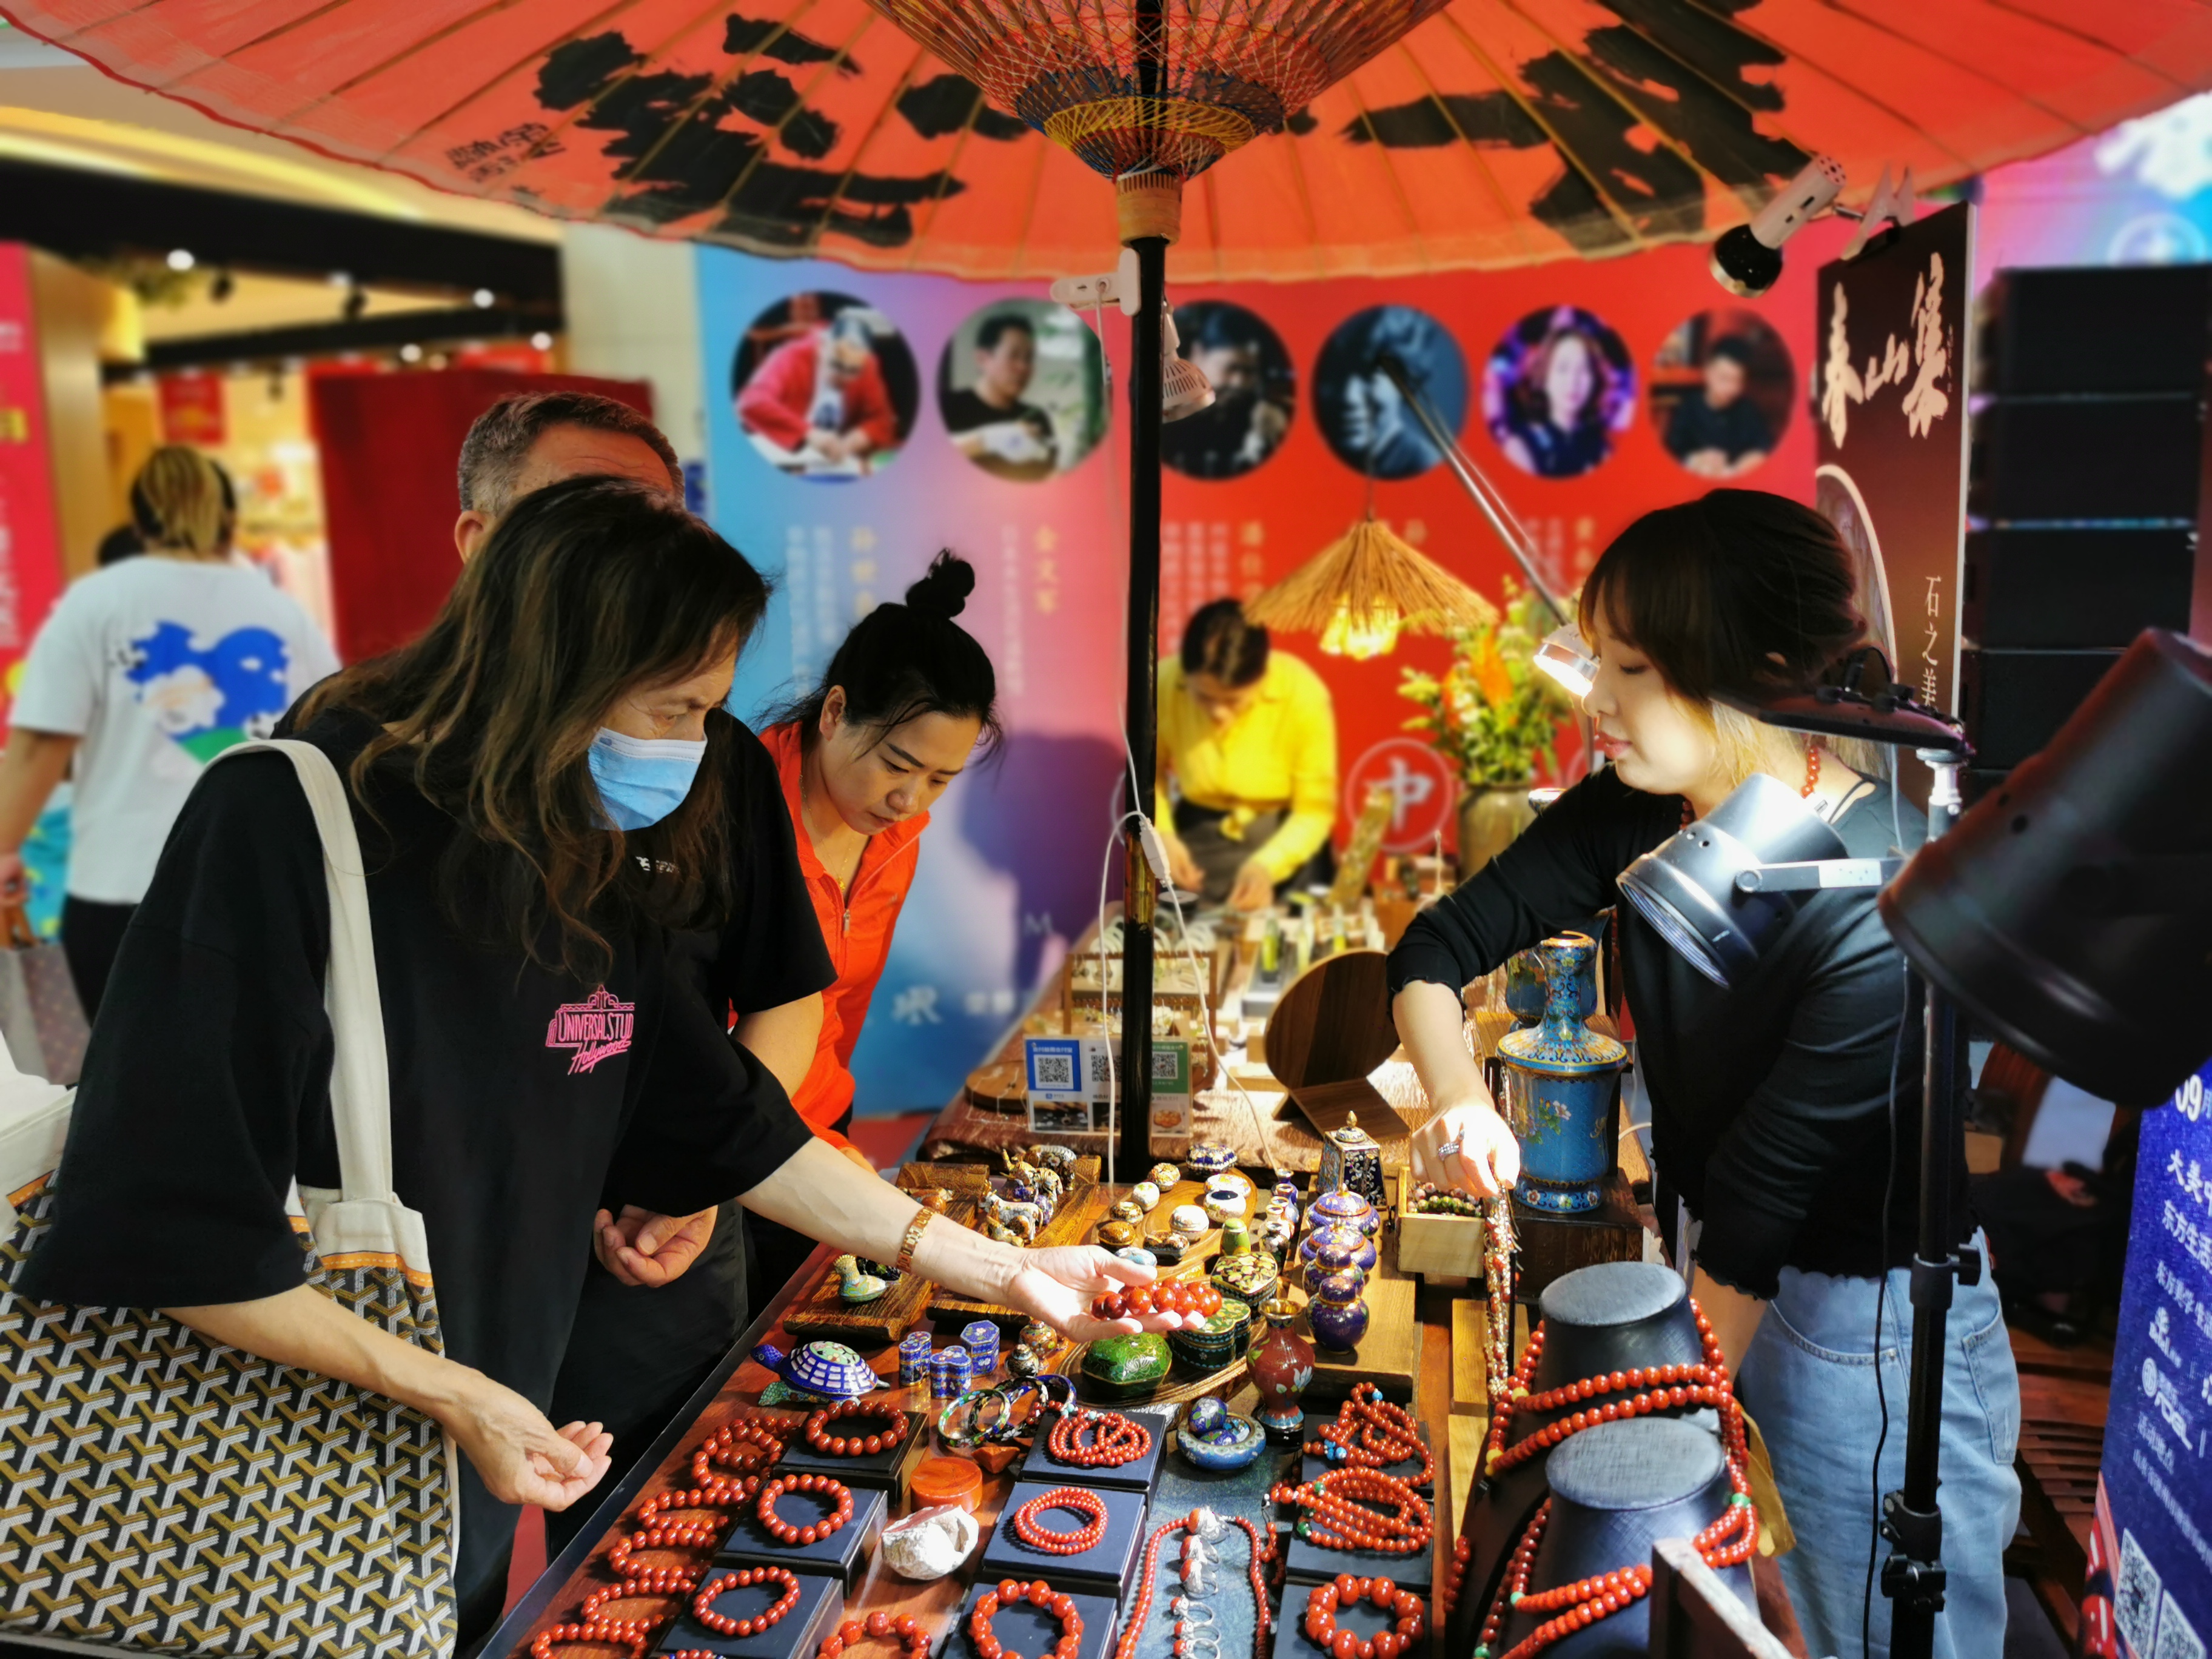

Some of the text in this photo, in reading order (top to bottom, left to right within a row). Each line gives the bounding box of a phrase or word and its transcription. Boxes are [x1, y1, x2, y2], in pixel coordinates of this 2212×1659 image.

[558, 1012, 606, 1042] UNIVERSAL
[2162, 1199, 2212, 1276] 东方生活
